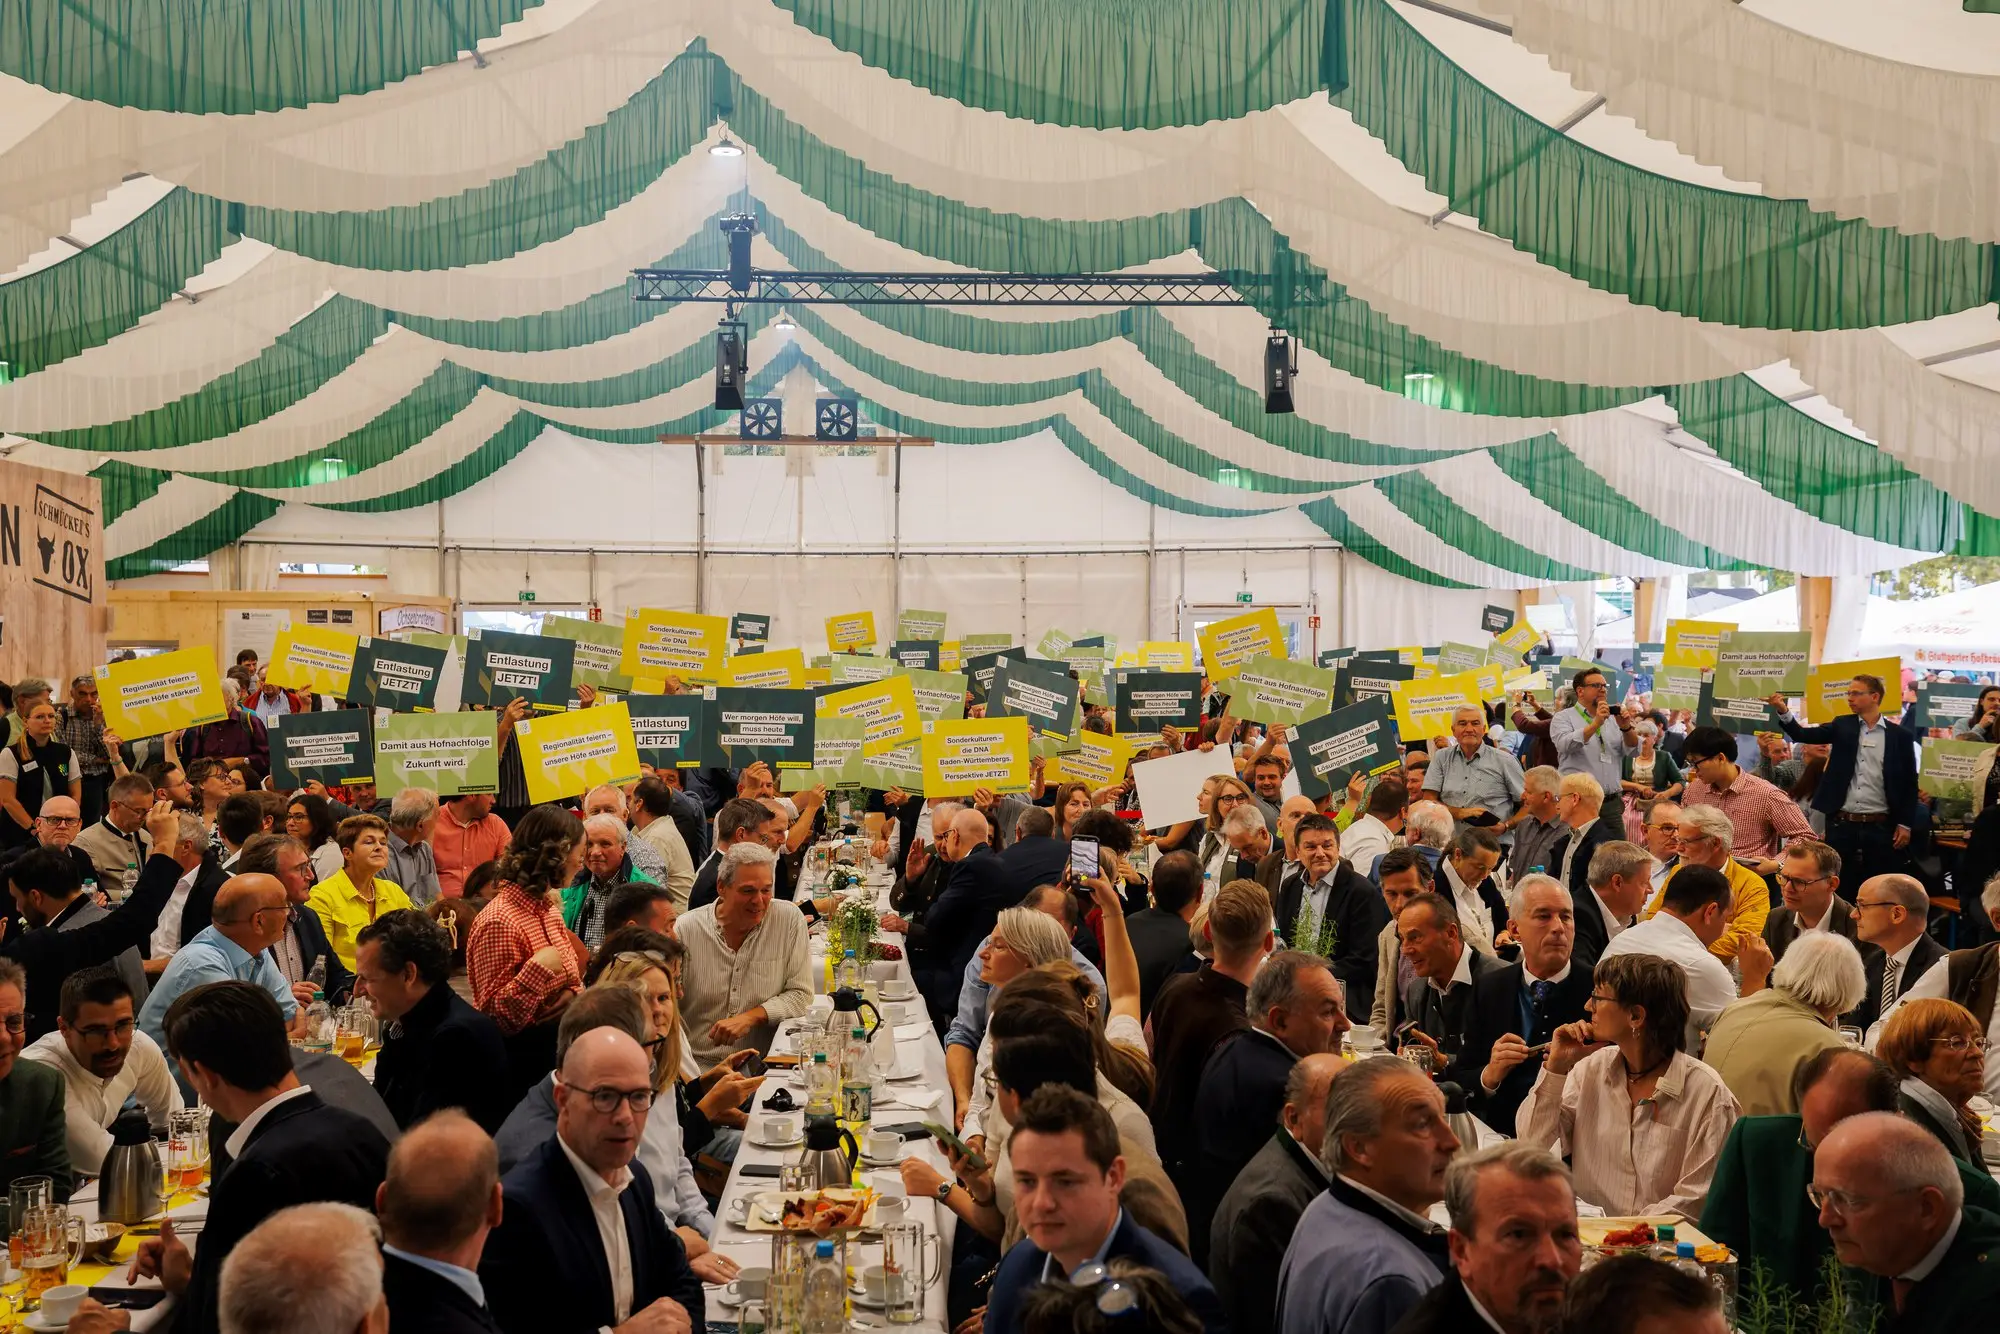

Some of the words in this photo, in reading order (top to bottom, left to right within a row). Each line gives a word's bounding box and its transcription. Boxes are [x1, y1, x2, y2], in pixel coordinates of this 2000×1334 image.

[62, 540, 89, 590] OX
[649, 625, 697, 636] Sonderkulturen
[1217, 627, 1256, 640] Sonderkulturen
[292, 644, 328, 657] Regionalität
[329, 651, 346, 660] feiern
[583, 644, 622, 656] Hofnachfo
[639, 643, 708, 657] Baden-Württembergs.
[489, 654, 549, 671] Entlastung
[641, 657, 679, 668] Perspektive
[679, 661, 702, 669] JETZT!
[1222, 658, 1242, 667] Perspek
[1759, 653, 1805, 661] Hofnachfolge
[1928, 651, 1969, 664] Stuttgarter
[288, 656, 309, 664] unsere
[310, 659, 325, 667] Höfe
[325, 663, 350, 672] stärken!
[376, 660, 431, 679] Entlastung
[591, 662, 610, 671] wird.
[735, 672, 767, 681] Regionalität
[977, 668, 995, 678] Entla
[122, 678, 167, 694] Regionalität
[168, 675, 190, 685] feiern
[382, 677, 419, 691] JETZT!
[497, 673, 537, 686] JETZT!
[768, 679, 790, 688] stärken!
[1242, 673, 1263, 684] Damit
[1278, 682, 1326, 698] Hofnachfolge
[1353, 678, 1390, 688] Entlastun
[125, 698, 150, 708] unsere
[151, 693, 169, 702] Höfe
[170, 686, 200, 698] stärken!
[917, 690, 961, 701] Hofnachfolge
[1010, 681, 1021, 689] Wer
[1021, 685, 1041, 695] morgen
[1042, 690, 1055, 699] Höfe
[1056, 694, 1066, 703] will,
[839, 698, 886, 714] Sonderkulturen
[1022, 694, 1035, 702] muss
[1036, 698, 1051, 707] heute
[1257, 693, 1284, 704] Zukunft
[1285, 700, 1303, 709] wird.
[1410, 696, 1442, 704] Regionalität
[865, 709, 880, 717] DNA
[925, 705, 941, 713] wird.
[1006, 698, 1032, 710] Lösungen
[1032, 706, 1057, 718] schaffen.
[1714, 709, 1742, 718] Lösungen
[631, 719, 687, 730] Entlastung
[769, 714, 786, 722] Höfe
[787, 715, 801, 723] will,
[865, 714, 903, 728] ürttembergs.
[881, 727, 903, 737] JETZT!
[1311, 744, 1324, 753] Wer
[1324, 735, 1349, 748] morgen
[1349, 728, 1365, 738] Höfe
[1365, 723, 1378, 733] will,
[302, 737, 327, 745] morgen
[380, 741, 408, 750] Damit
[429, 738, 490, 748] Hofnachfolge
[543, 738, 585, 752] Regionalität
[586, 733, 607, 742] feiern
[638, 736, 677, 745] JETZT!
[724, 736, 758, 744] Lösungen
[759, 736, 792, 744] schaffen.
[820, 740, 860, 749] Hofnachfolge
[947, 736, 998, 744] Sonderkulturen
[1330, 748, 1347, 756] muss
[1347, 740, 1366, 750] heute
[290, 758, 321, 766] Lösungen
[322, 756, 352, 764] schaffen.
[544, 756, 569, 766] unsere
[570, 752, 587, 761] Höfe
[588, 745, 617, 757] stärken!
[940, 756, 1012, 766] Baden-Württembergs.
[1317, 758, 1348, 772] Lösungen
[1348, 747, 1377, 760] schaffen.
[405, 759, 441, 769] Zukunft
[443, 758, 466, 767] wird.
[829, 758, 844, 766] wird.
[945, 771, 984, 780] Perspektive
[985, 770, 1008, 778] JETZT!
[1061, 767, 1090, 778] Perspektive
[1090, 774, 1108, 782] JETZT!
